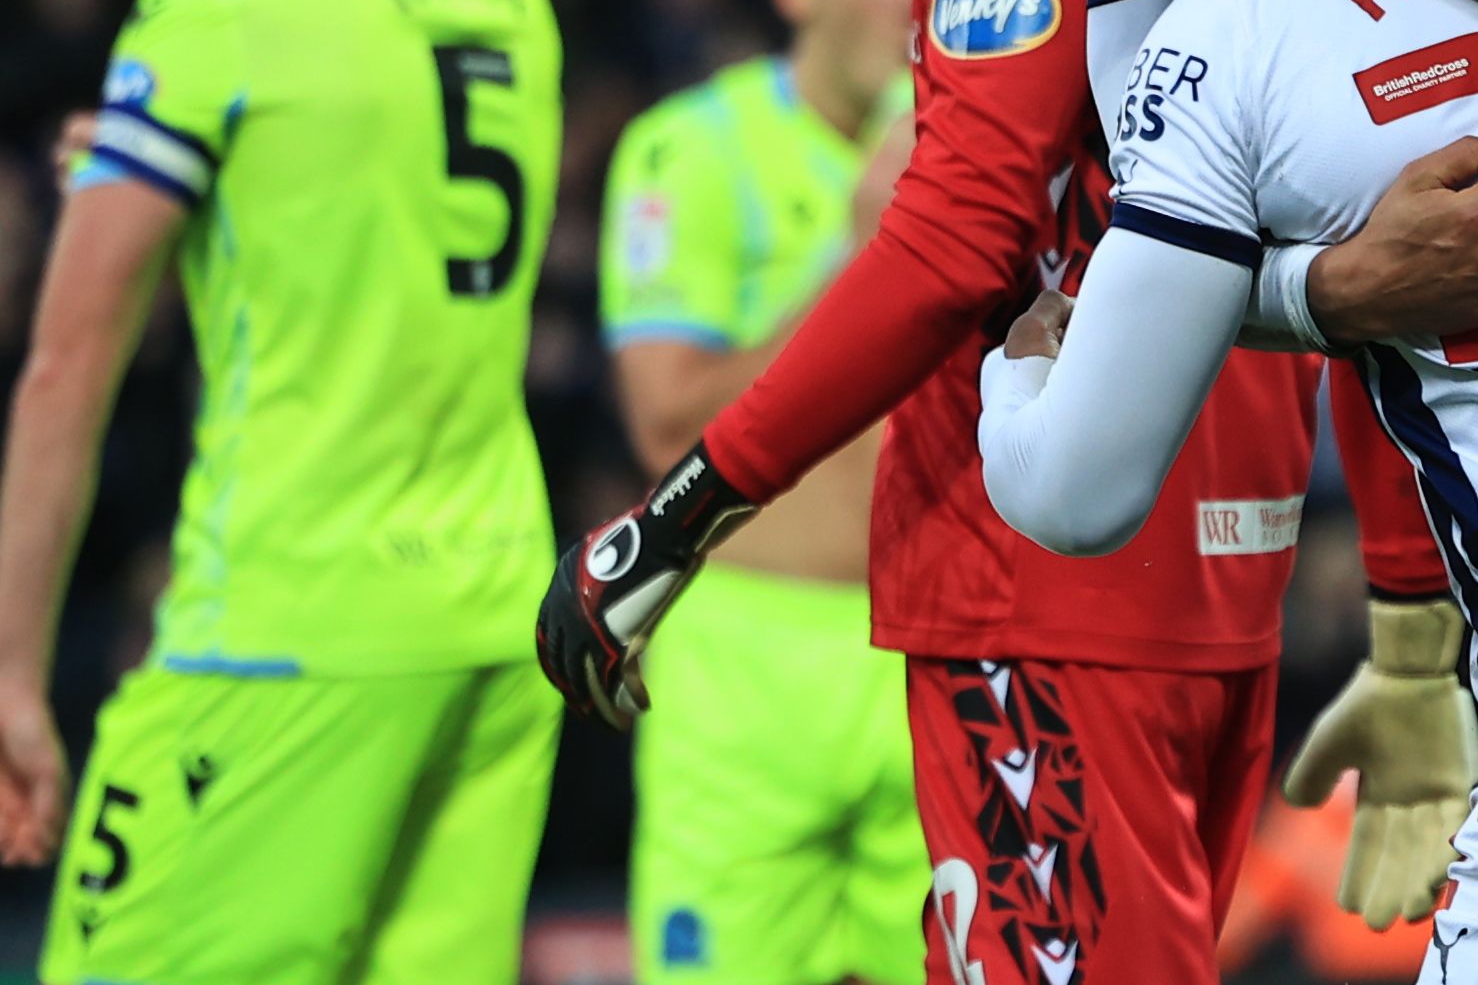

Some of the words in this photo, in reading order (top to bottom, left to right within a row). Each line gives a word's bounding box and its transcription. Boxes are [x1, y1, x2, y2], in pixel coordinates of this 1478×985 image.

[1385, 88, 1413, 101] OFFICIAL
[1413, 79, 1438, 92] CHARITY
[1439, 69, 1467, 83] PARTNER
[433, 44, 523, 295] 5
[1202, 510, 1242, 545] WR
[80, 785, 138, 893] 5
